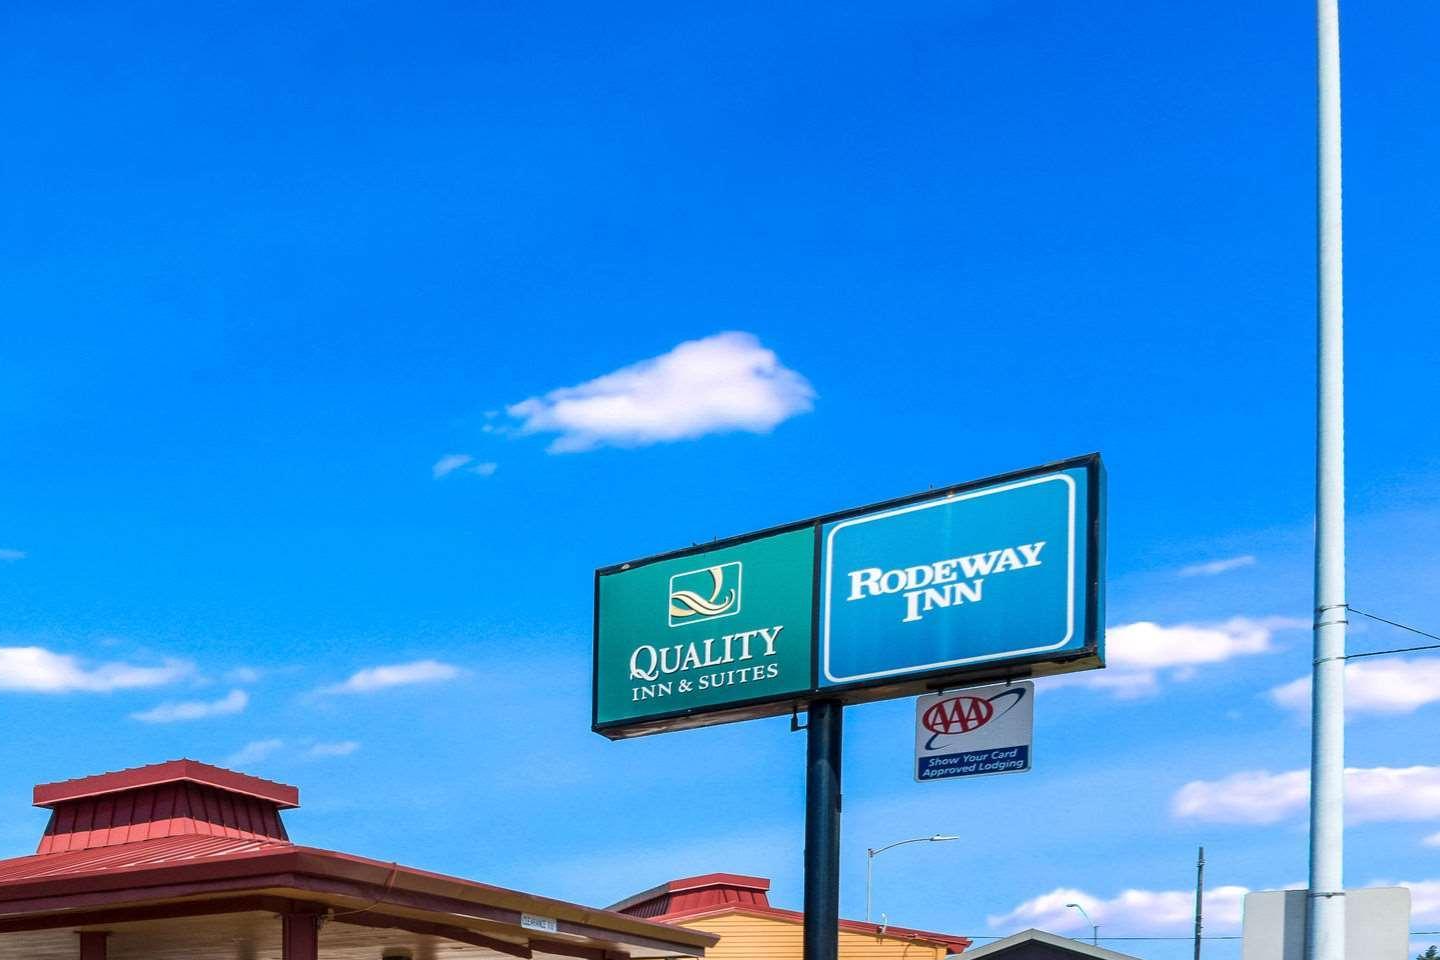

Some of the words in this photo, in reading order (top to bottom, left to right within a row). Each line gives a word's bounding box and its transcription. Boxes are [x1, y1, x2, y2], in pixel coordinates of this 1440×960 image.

[847, 541, 1046, 601] RODEWAY
[902, 579, 984, 623] INN
[629, 625, 784, 682] QUALITY
[632, 681, 673, 701] INN
[678, 679, 693, 693] &
[698, 663, 779, 690] SUITES
[926, 697, 990, 734] AAA
[922, 763, 977, 777] Approved
[978, 759, 1024, 771] Lodging
[928, 757, 960, 767] Show
[963, 754, 989, 763] Your
[991, 748, 1018, 759] Card
